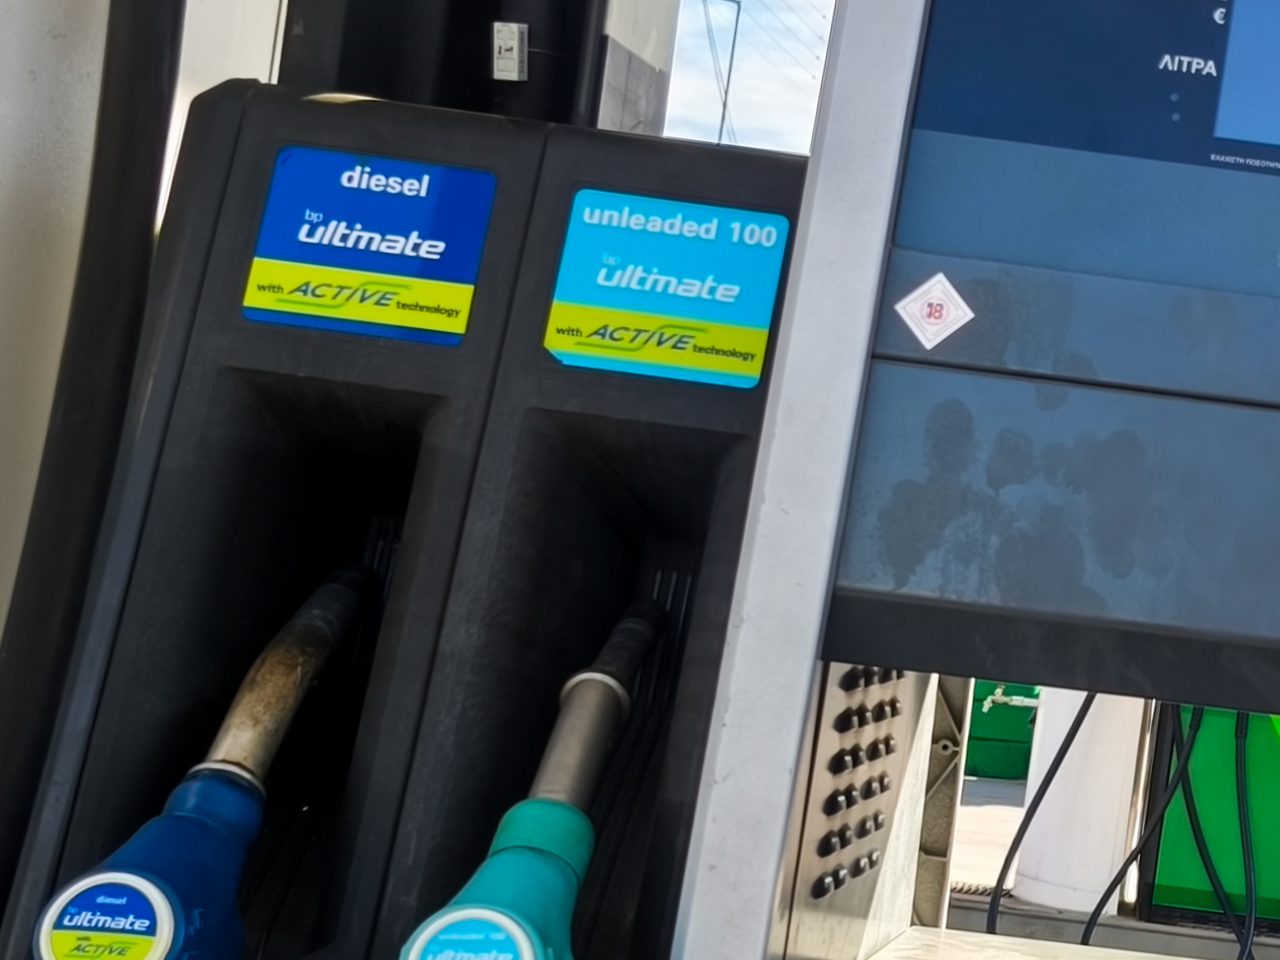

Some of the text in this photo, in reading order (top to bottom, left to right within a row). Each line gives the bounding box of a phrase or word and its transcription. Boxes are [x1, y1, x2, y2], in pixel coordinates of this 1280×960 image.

[1213, 8, 1226, 25] €
[1159, 54, 1217, 77] ΛΙΤΡΑ
[340, 165, 430, 197] diesel
[305, 208, 323, 223] bp
[583, 206, 777, 247] unleaded 100
[298, 220, 446, 260] ultimate
[596, 264, 740, 303] ultimate
[256, 281, 461, 319] with ACTIVE technology
[927, 302, 944, 320] 18
[556, 324, 757, 362] with ACTIVE technology
[63, 911, 150, 931] ultimate
[70, 943, 132, 957] ACTIVE
